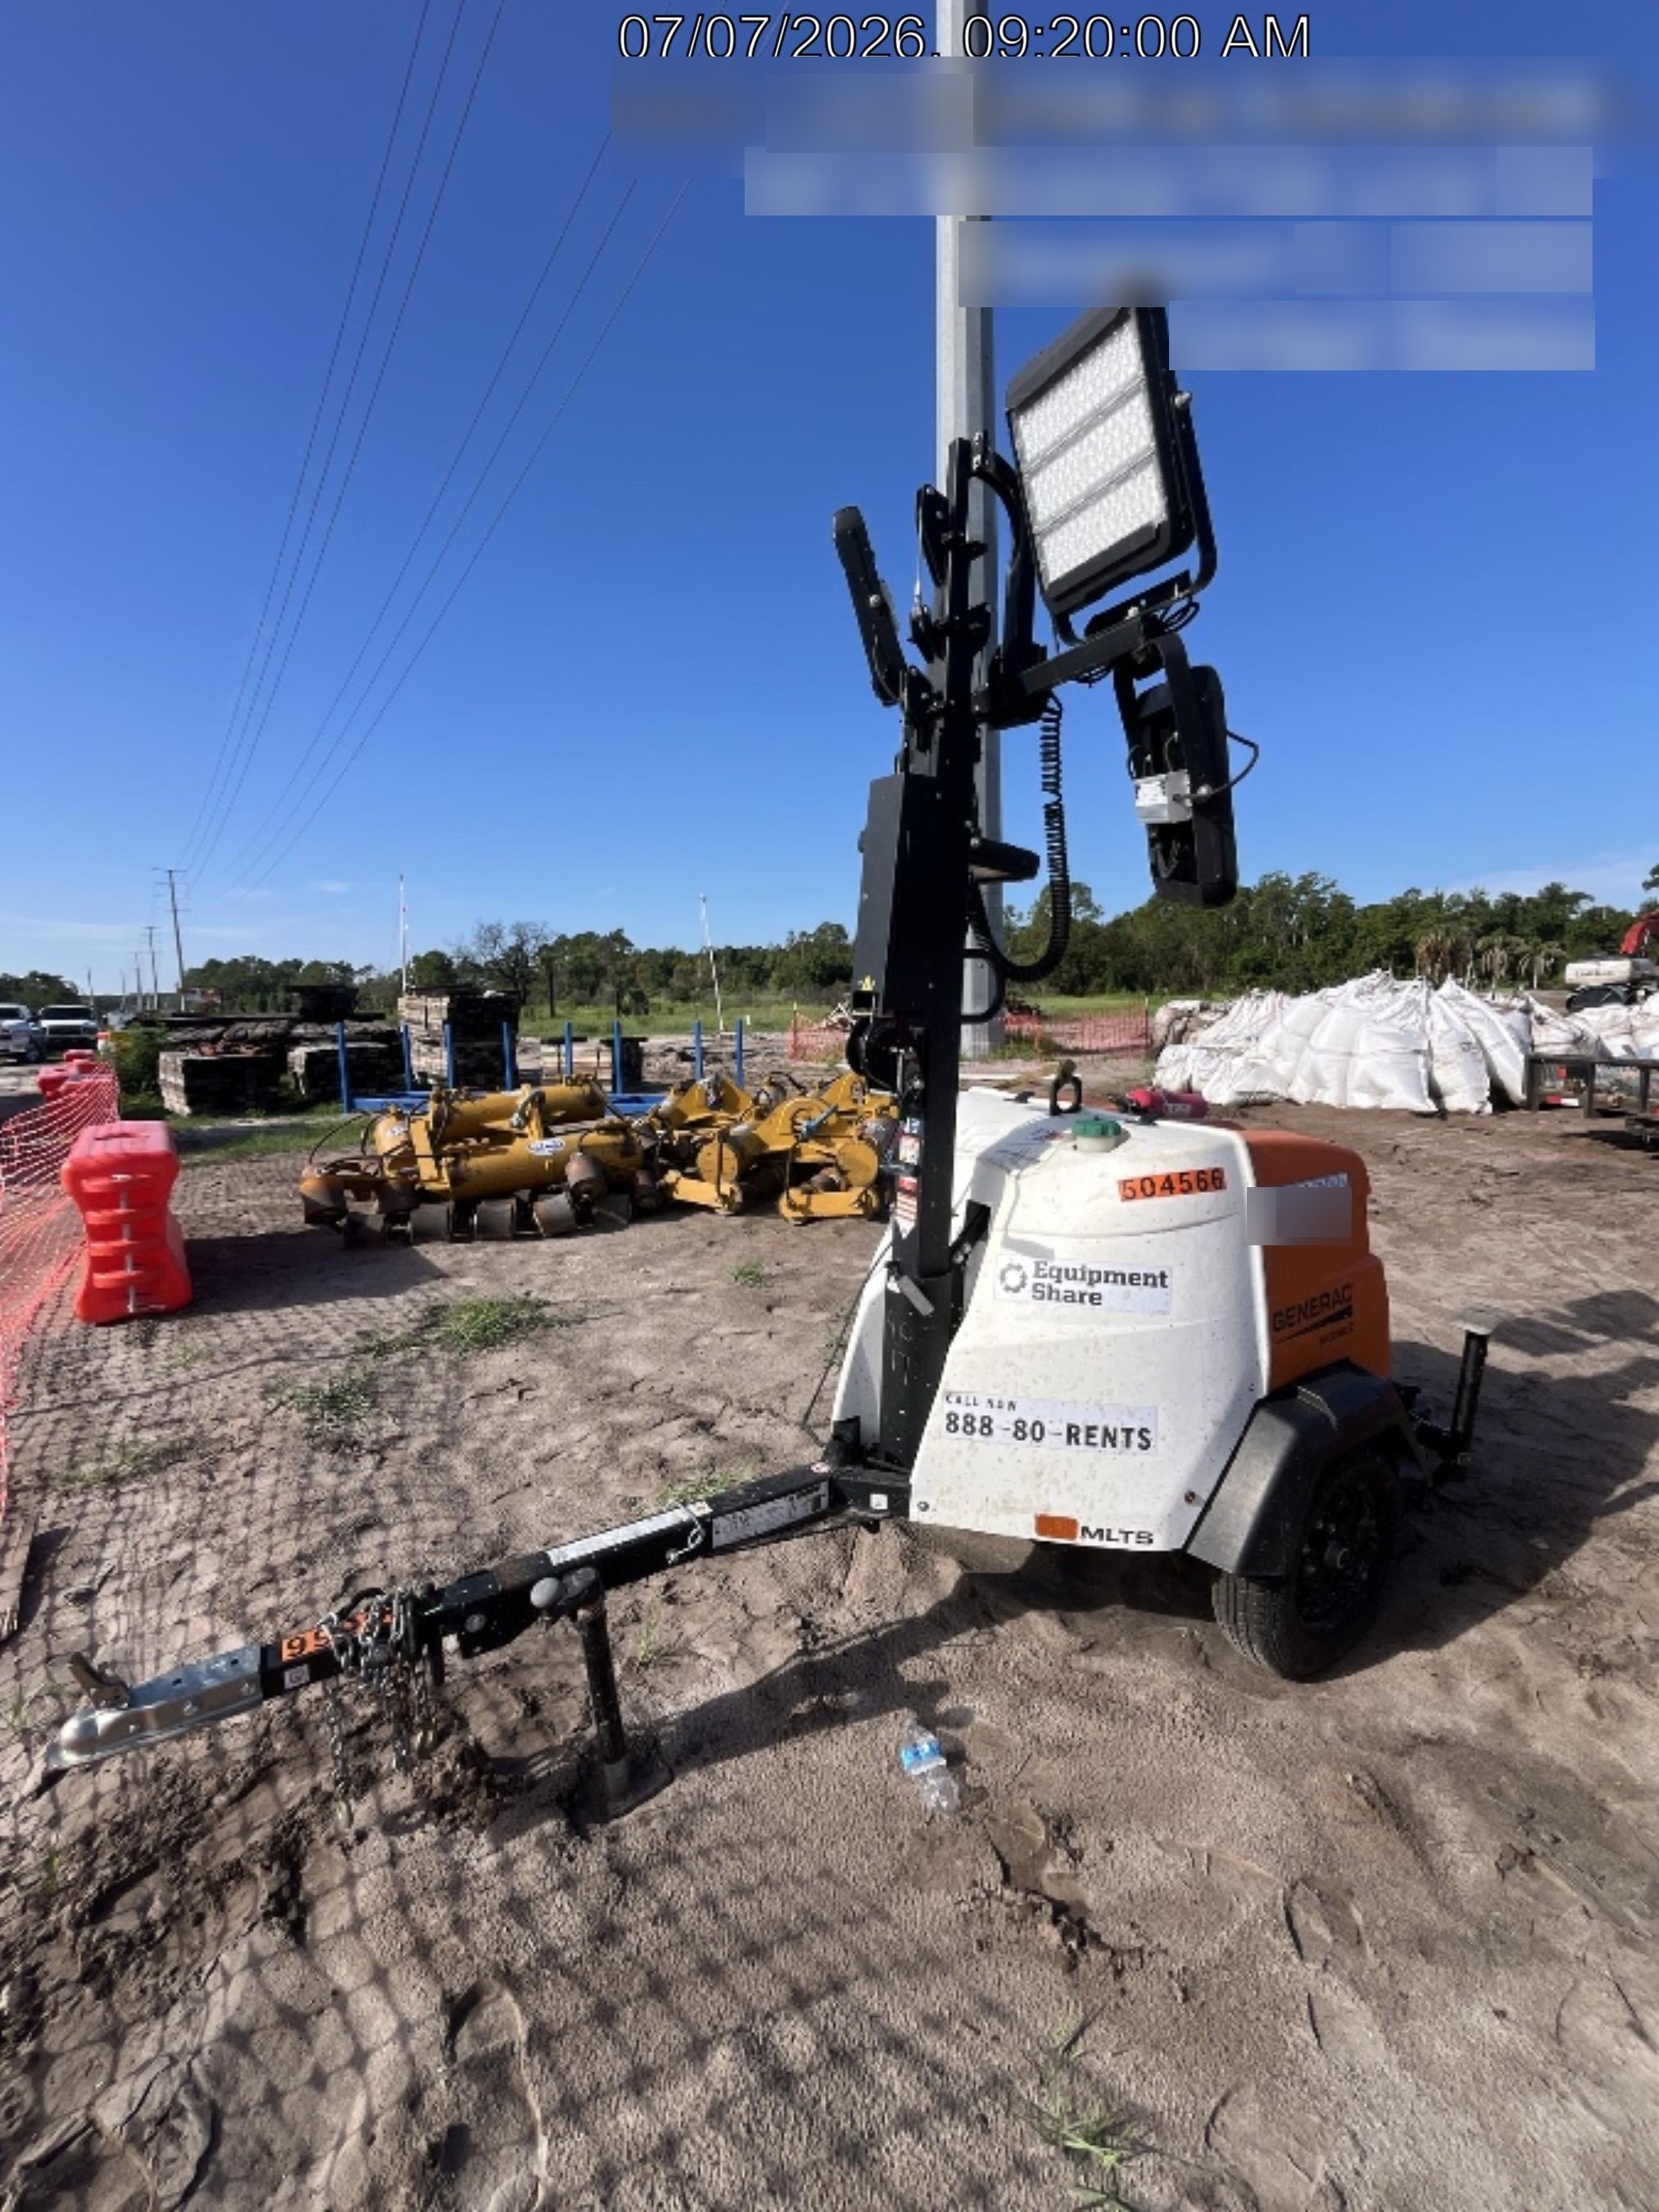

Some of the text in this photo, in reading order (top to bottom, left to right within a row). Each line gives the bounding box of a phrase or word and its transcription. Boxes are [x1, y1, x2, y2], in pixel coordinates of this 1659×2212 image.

[1122, 1167, 1222, 1199] 504566
[1033, 1261, 1168, 1289] Equipment
[1032, 1283, 1102, 1306] Share
[1272, 1282, 1355, 1332] GENERAC
